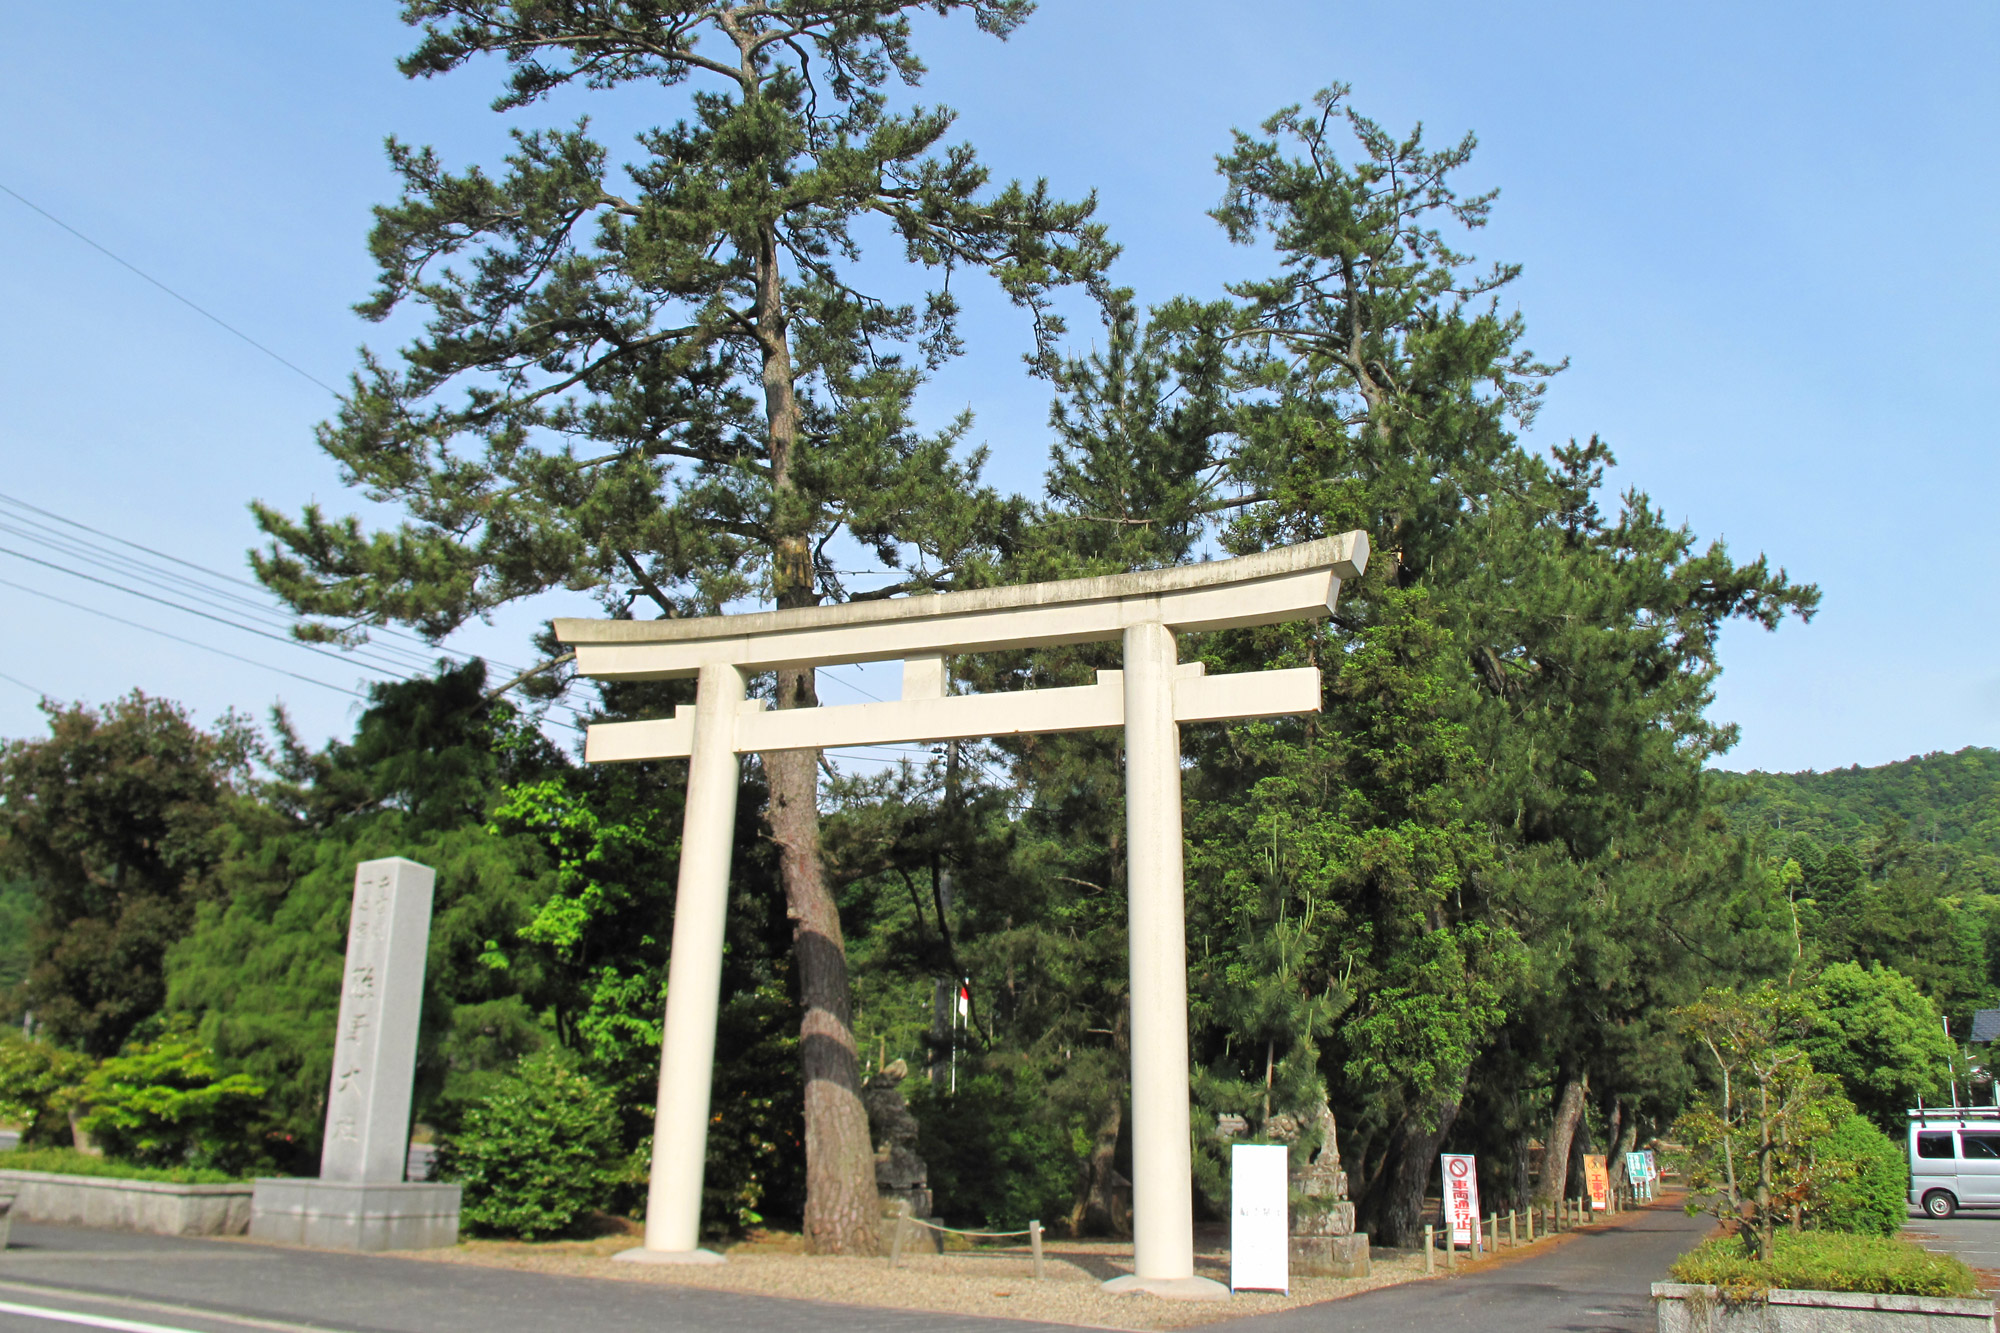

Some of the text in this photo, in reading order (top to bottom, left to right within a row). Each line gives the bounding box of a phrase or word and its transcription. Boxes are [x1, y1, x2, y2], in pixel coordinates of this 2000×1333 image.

[1452, 1179, 1471, 1230] 車両通行止
[1592, 1174, 1604, 1200] 工事中
